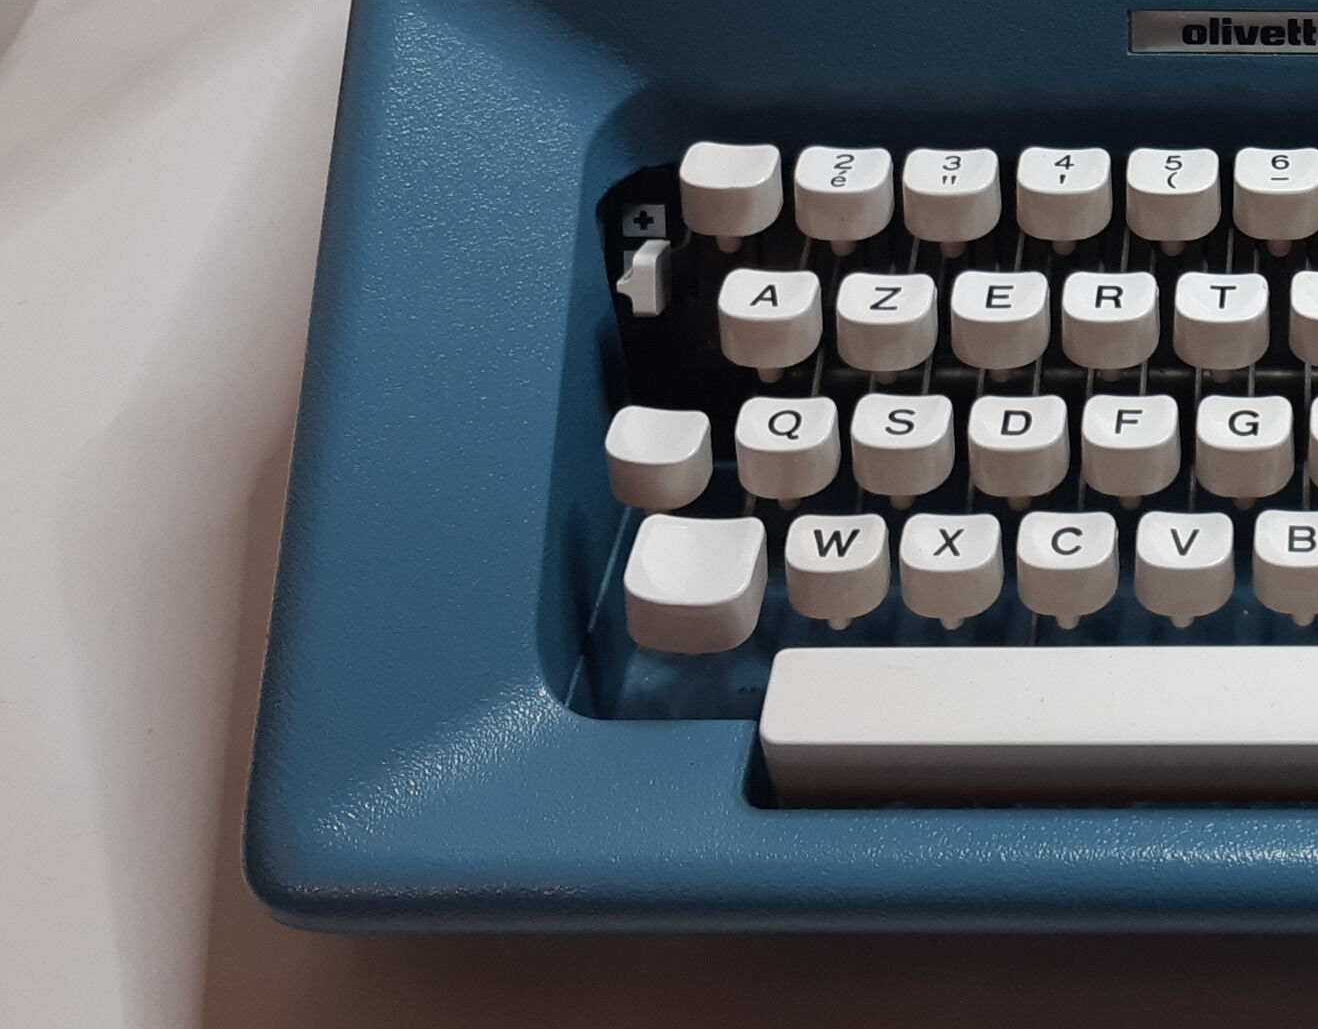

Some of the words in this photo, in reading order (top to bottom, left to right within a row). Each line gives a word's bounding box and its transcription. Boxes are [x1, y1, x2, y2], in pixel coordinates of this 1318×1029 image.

[833, 153, 856, 171] 2
[941, 154, 962, 172] 3
[1053, 153, 1076, 171] 4
[1163, 154, 1184, 172] 5
[1270, 153, 1291, 171] 6
[830, 170, 848, 188] é
[1166, 171, 1179, 190] (
[749, 283, 779, 308] A
[868, 286, 903, 312] Z
[984, 284, 1015, 310] E
[1094, 284, 1125, 310] R
[1209, 284, 1238, 310] T
[767, 409, 803, 441] Q
[884, 408, 917, 436] S
[999, 409, 1033, 437] D
[1114, 408, 1144, 435] F
[1227, 409, 1261, 437] G
[812, 528, 861, 559] W
[932, 527, 965, 558] X
[1050, 525, 1084, 557] C
[1169, 527, 1201, 557] V
[1287, 524, 1318, 554] B
